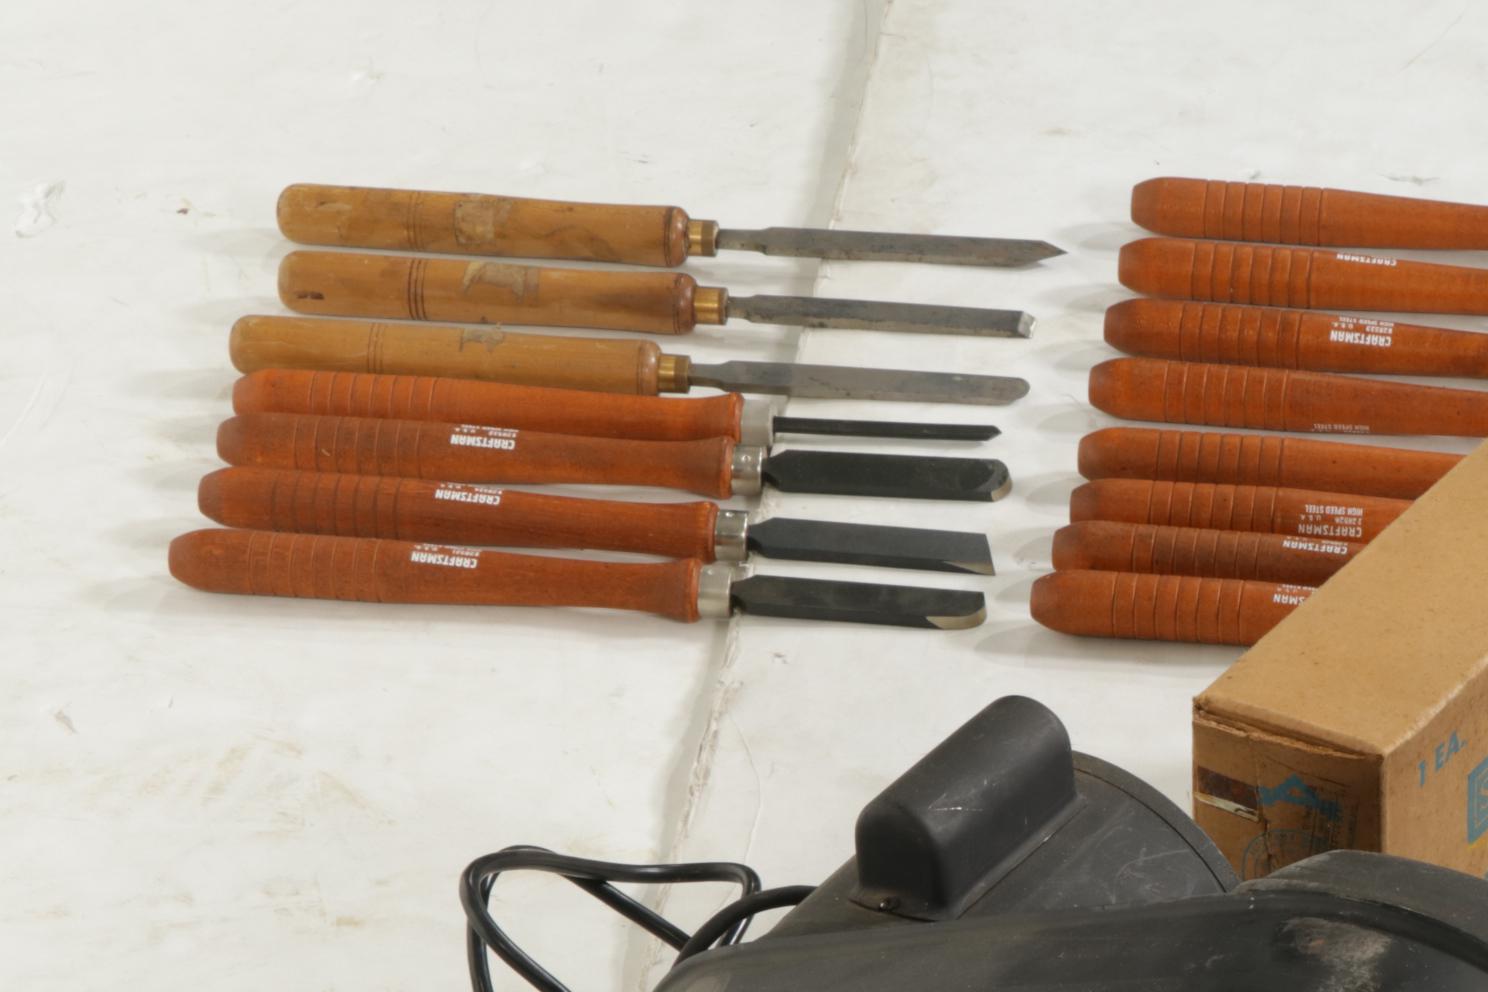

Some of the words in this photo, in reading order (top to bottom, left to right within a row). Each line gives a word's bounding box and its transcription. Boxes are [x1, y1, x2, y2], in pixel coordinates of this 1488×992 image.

[1336, 253, 1397, 267] CRAFTSMAN
[1329, 329, 1392, 347] CRAFTSMAN
[449, 433, 516, 450] CRAFTSMAN
[435, 488, 501, 505] CRAFTSMAN
[1305, 503, 1324, 514] STEEL
[1297, 524, 1362, 538] CRAFTSMAN
[1282, 539, 1348, 555] CRAFTSMAN
[410, 550, 478, 569] CRAFTSMAN
